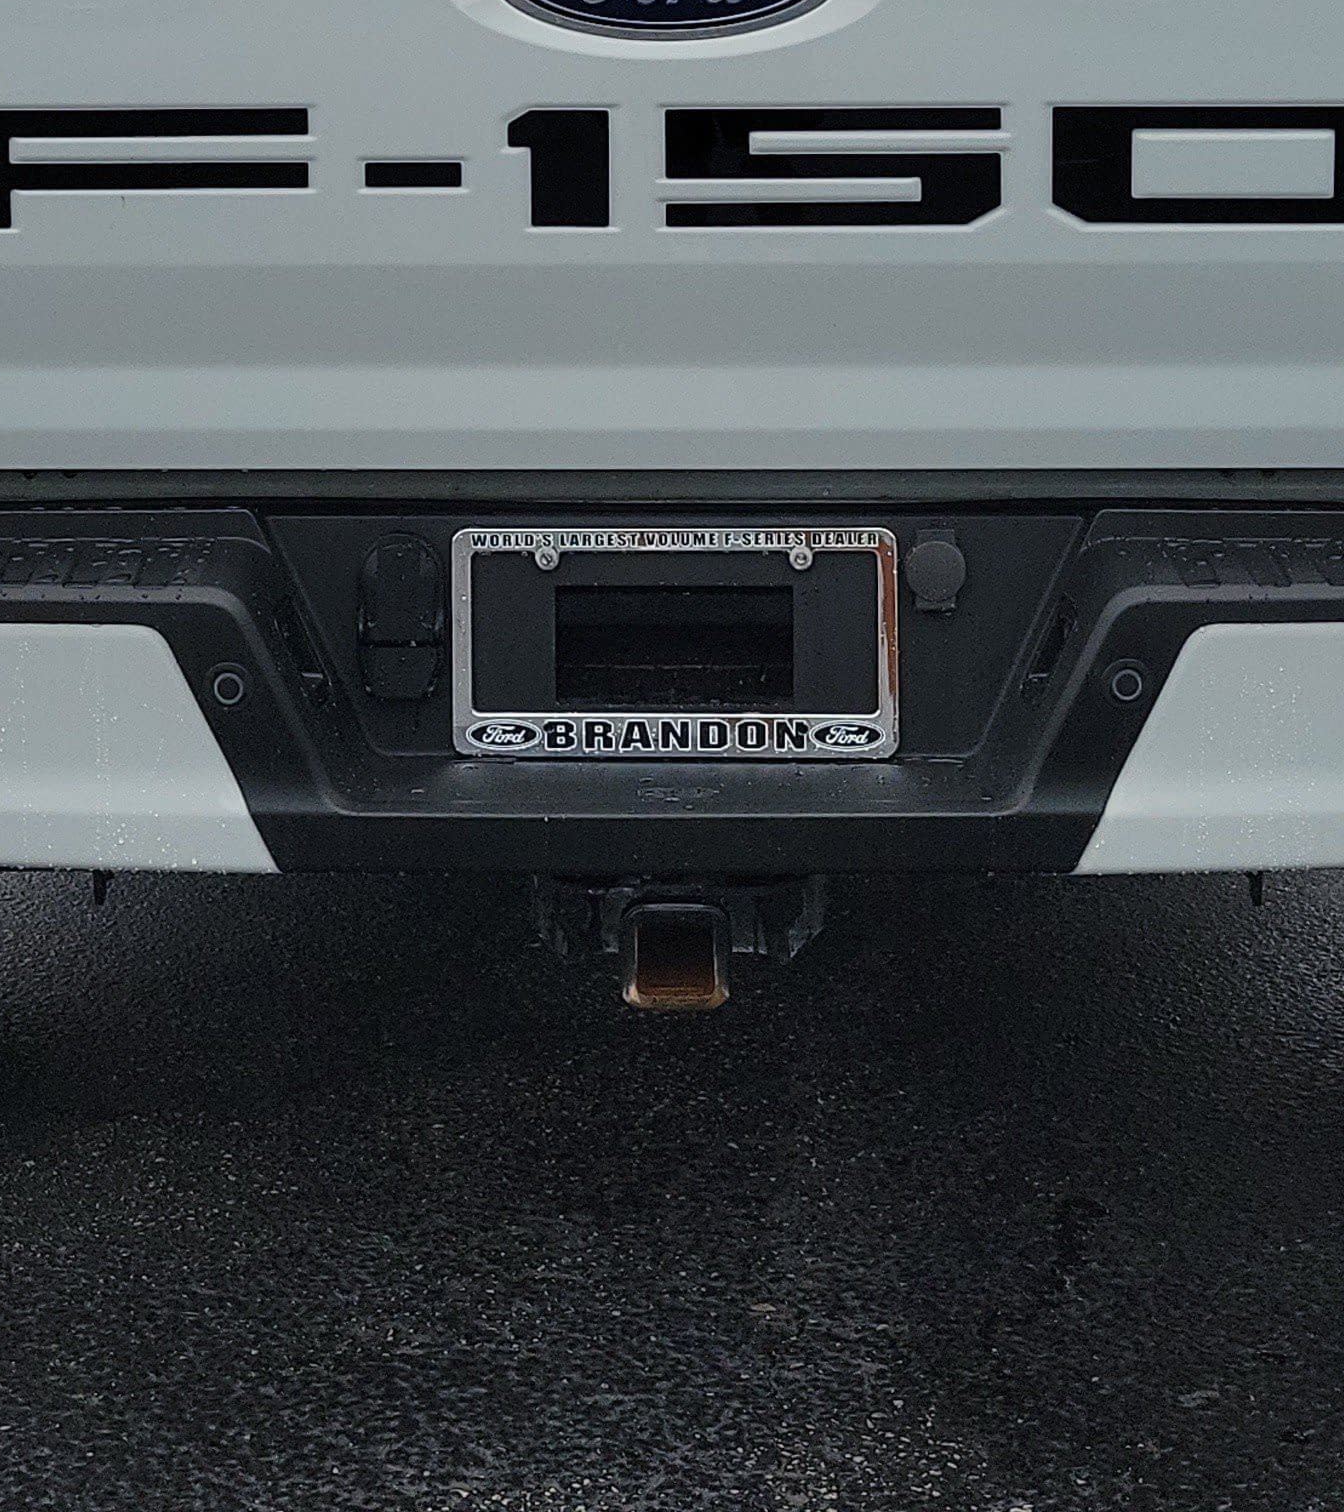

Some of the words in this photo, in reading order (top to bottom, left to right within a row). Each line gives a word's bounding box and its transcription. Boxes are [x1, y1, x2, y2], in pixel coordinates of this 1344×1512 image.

[471, 532, 553, 548] WORLD'S
[559, 532, 639, 548] LARGEST
[645, 531, 719, 547] VOLUME
[724, 531, 805, 547] F-SERIES
[811, 530, 880, 547] DEALER
[482, 724, 526, 744] Ford
[543, 719, 810, 751] BRANDON
[825, 725, 870, 745] Ford
